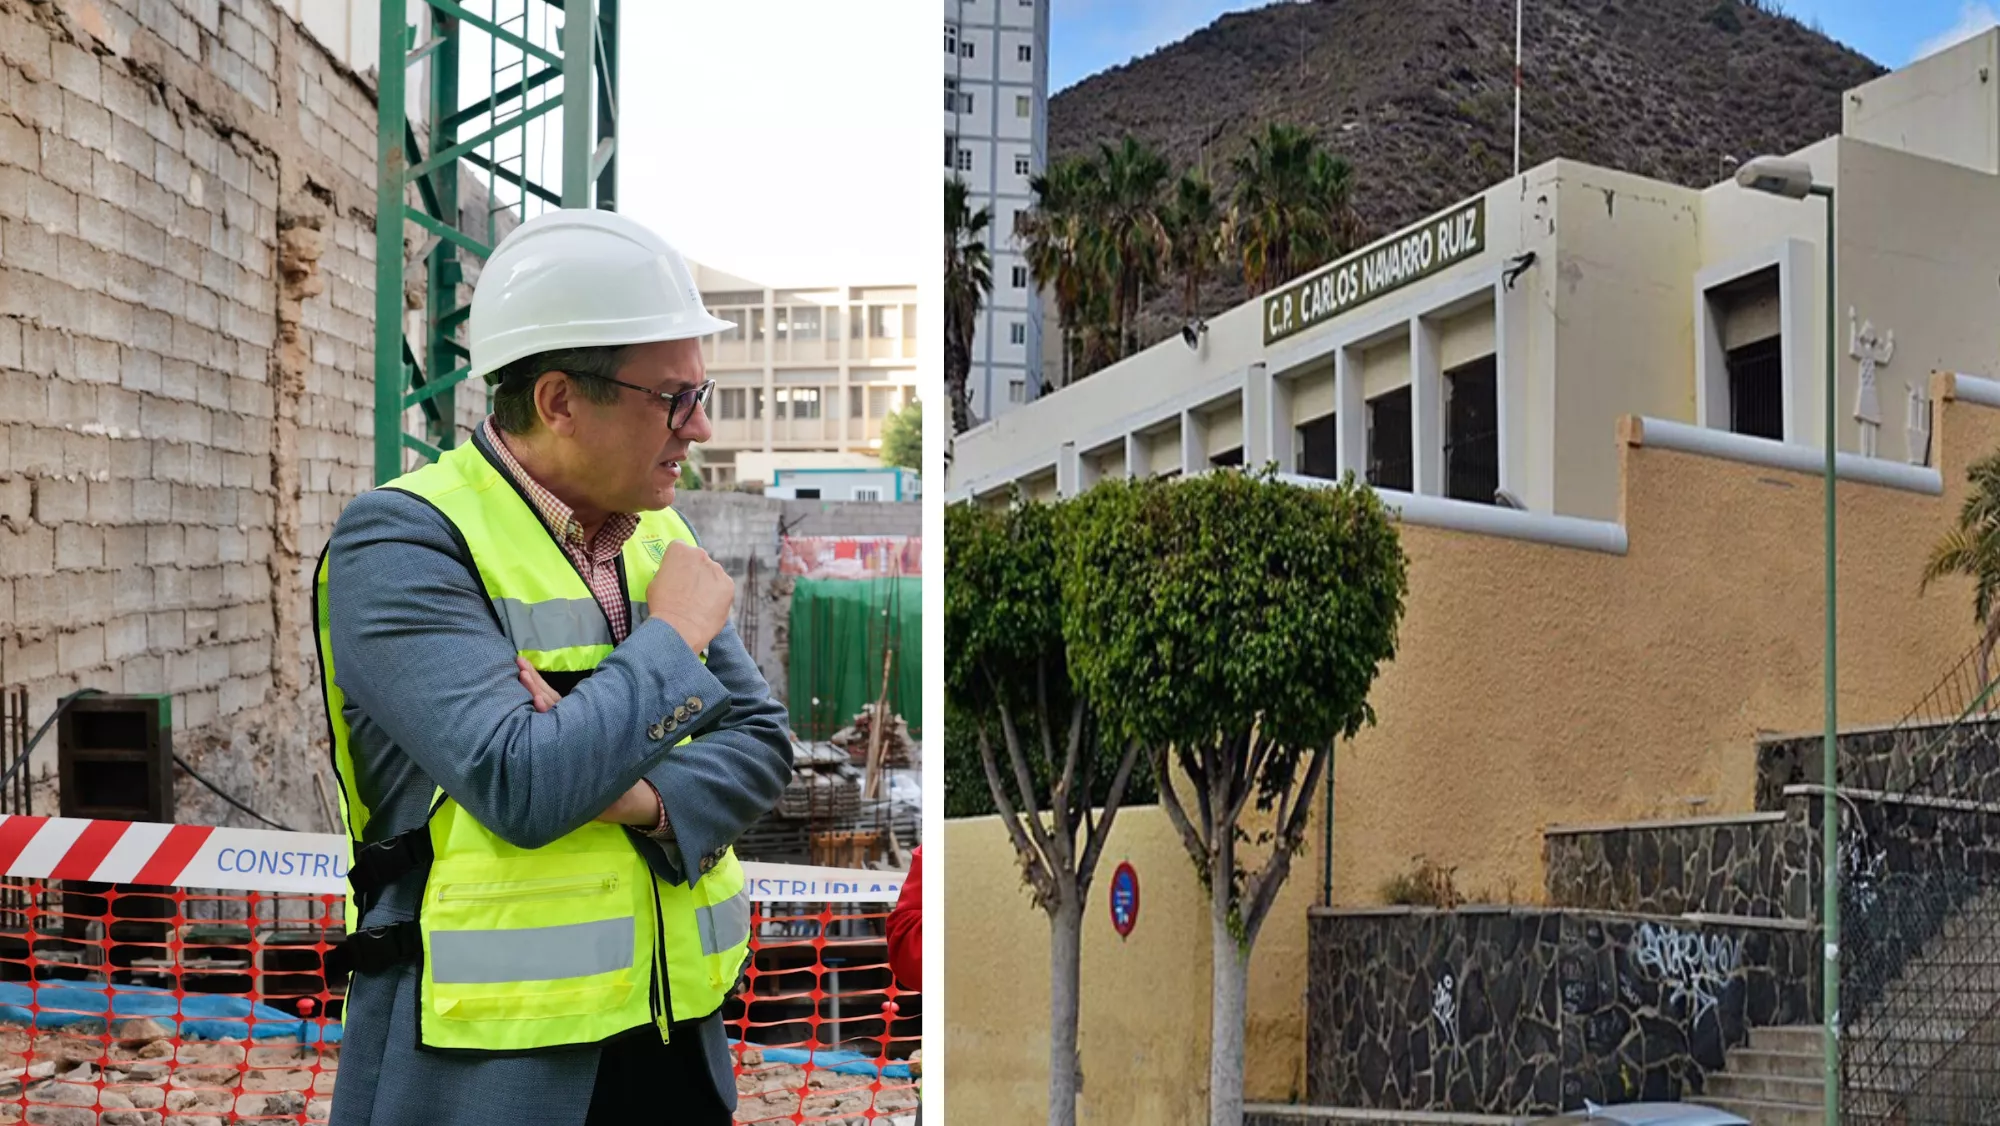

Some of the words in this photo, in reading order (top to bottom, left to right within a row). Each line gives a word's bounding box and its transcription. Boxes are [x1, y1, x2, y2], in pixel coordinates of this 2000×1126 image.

[1269, 295, 1293, 336] C.P.
[1300, 263, 1358, 322] CARLOS
[1362, 229, 1432, 294] NAVARRO
[1437, 208, 1477, 261] RUIZ
